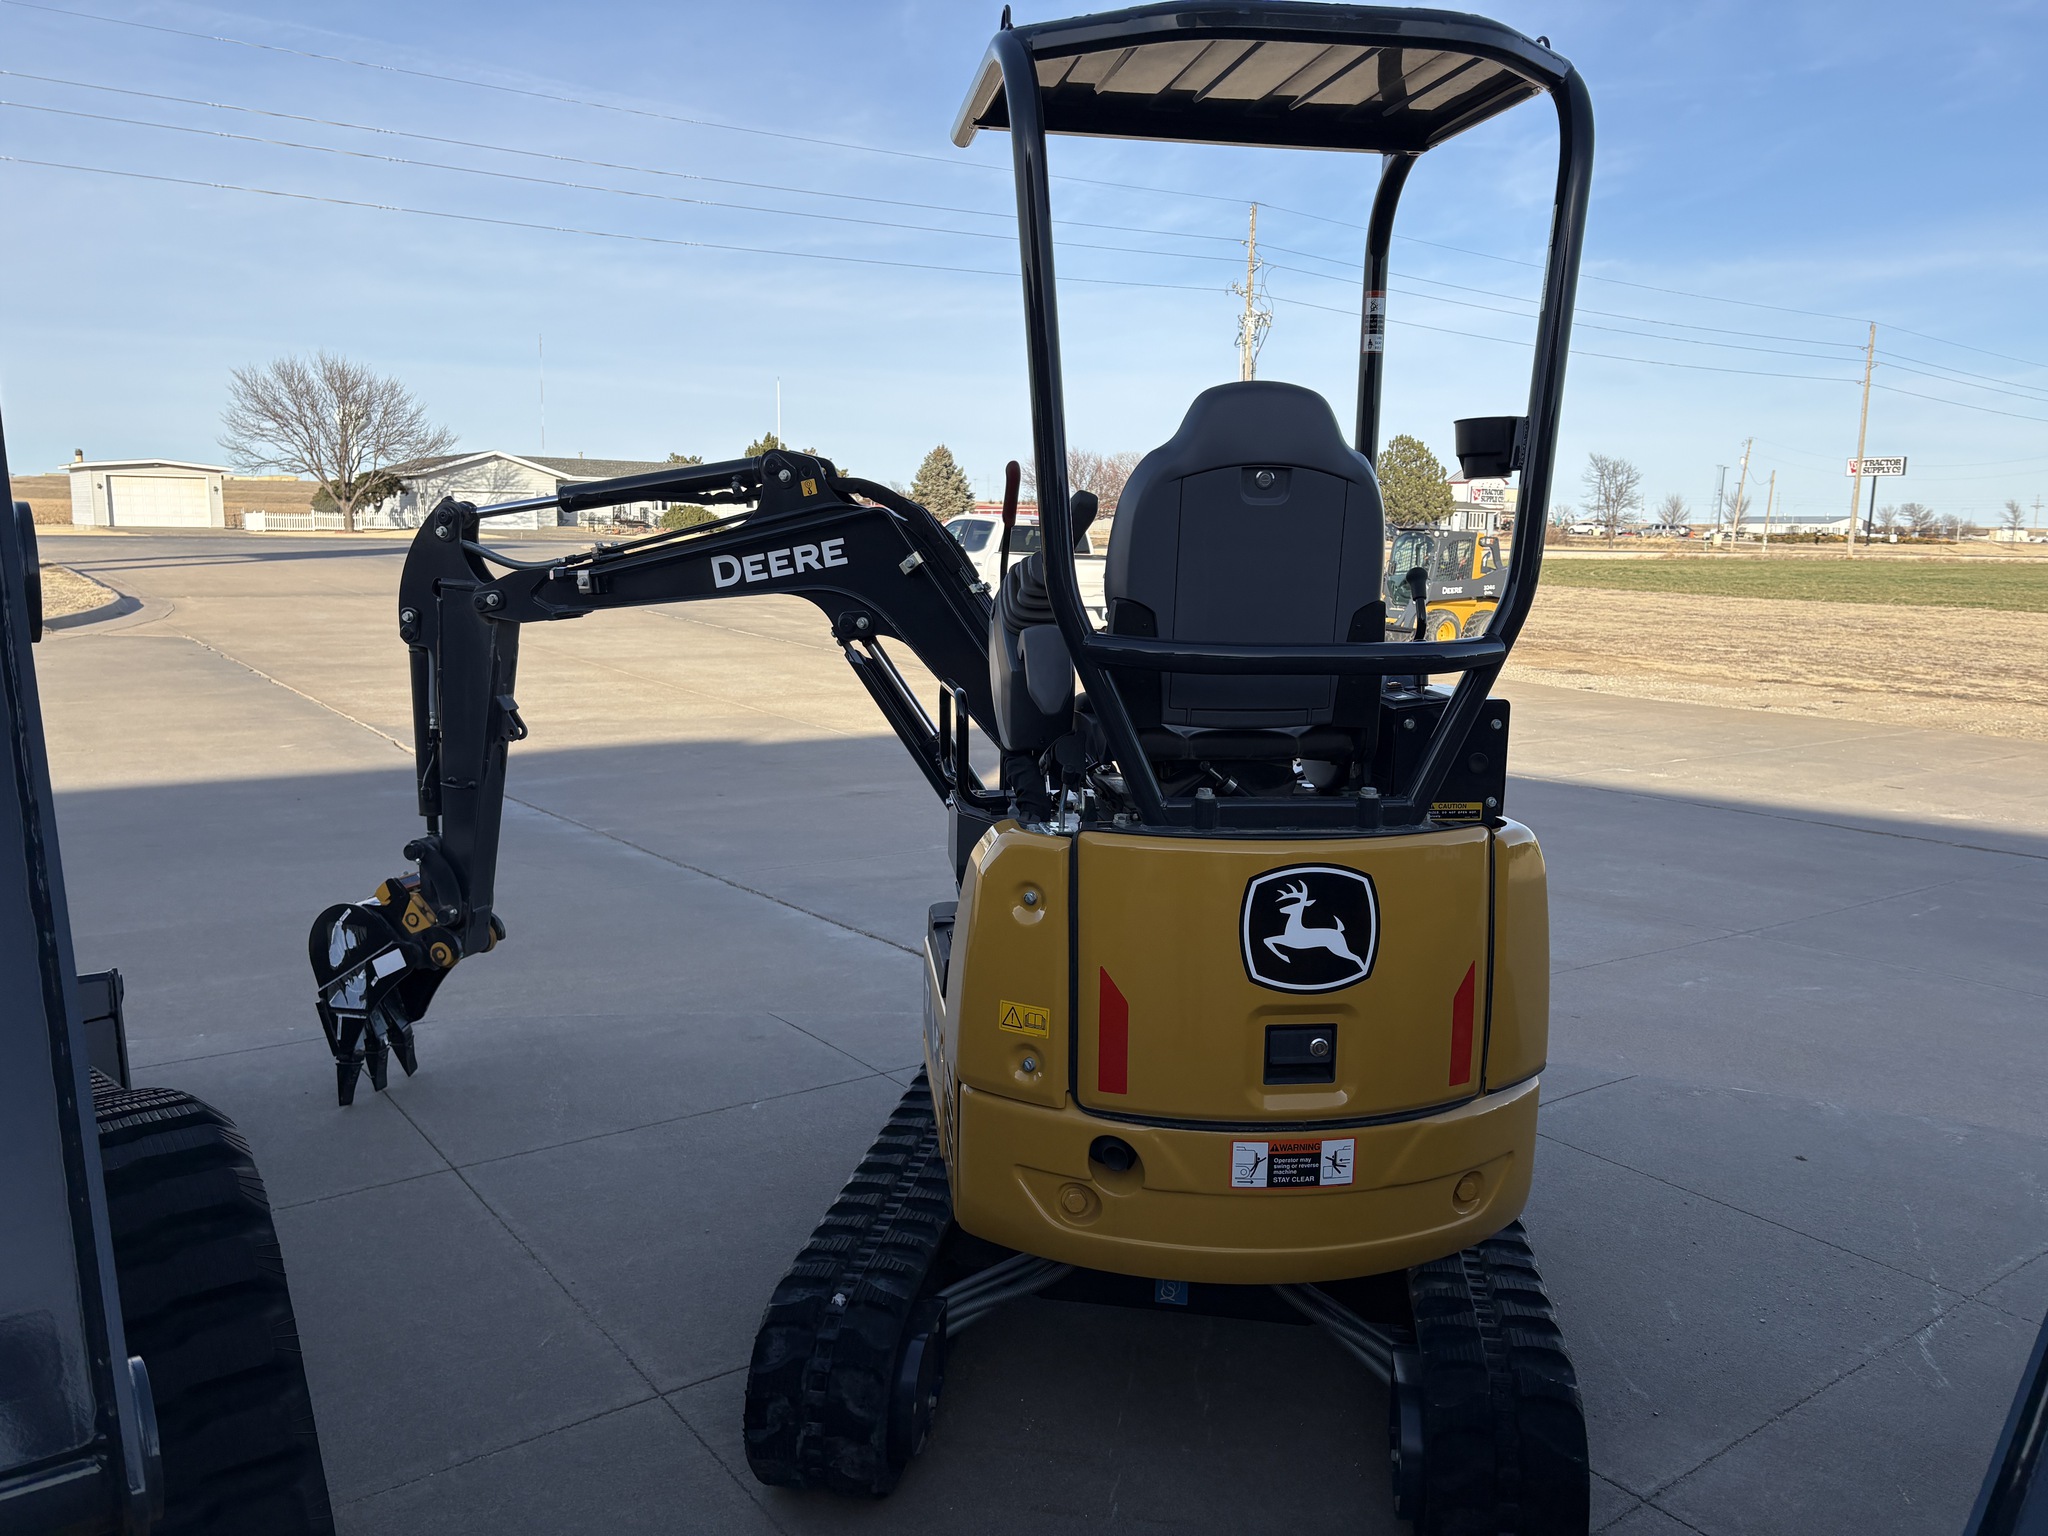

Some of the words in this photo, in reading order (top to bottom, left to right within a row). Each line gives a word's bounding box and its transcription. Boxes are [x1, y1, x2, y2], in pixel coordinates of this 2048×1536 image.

[1863, 459, 1902, 467] TRACTOR
[1862, 466, 1891, 474] SUPPLY
[710, 537, 849, 589] DEERE
[1442, 586, 1463, 595] DEERE
[1279, 1143, 1320, 1152] WARNING
